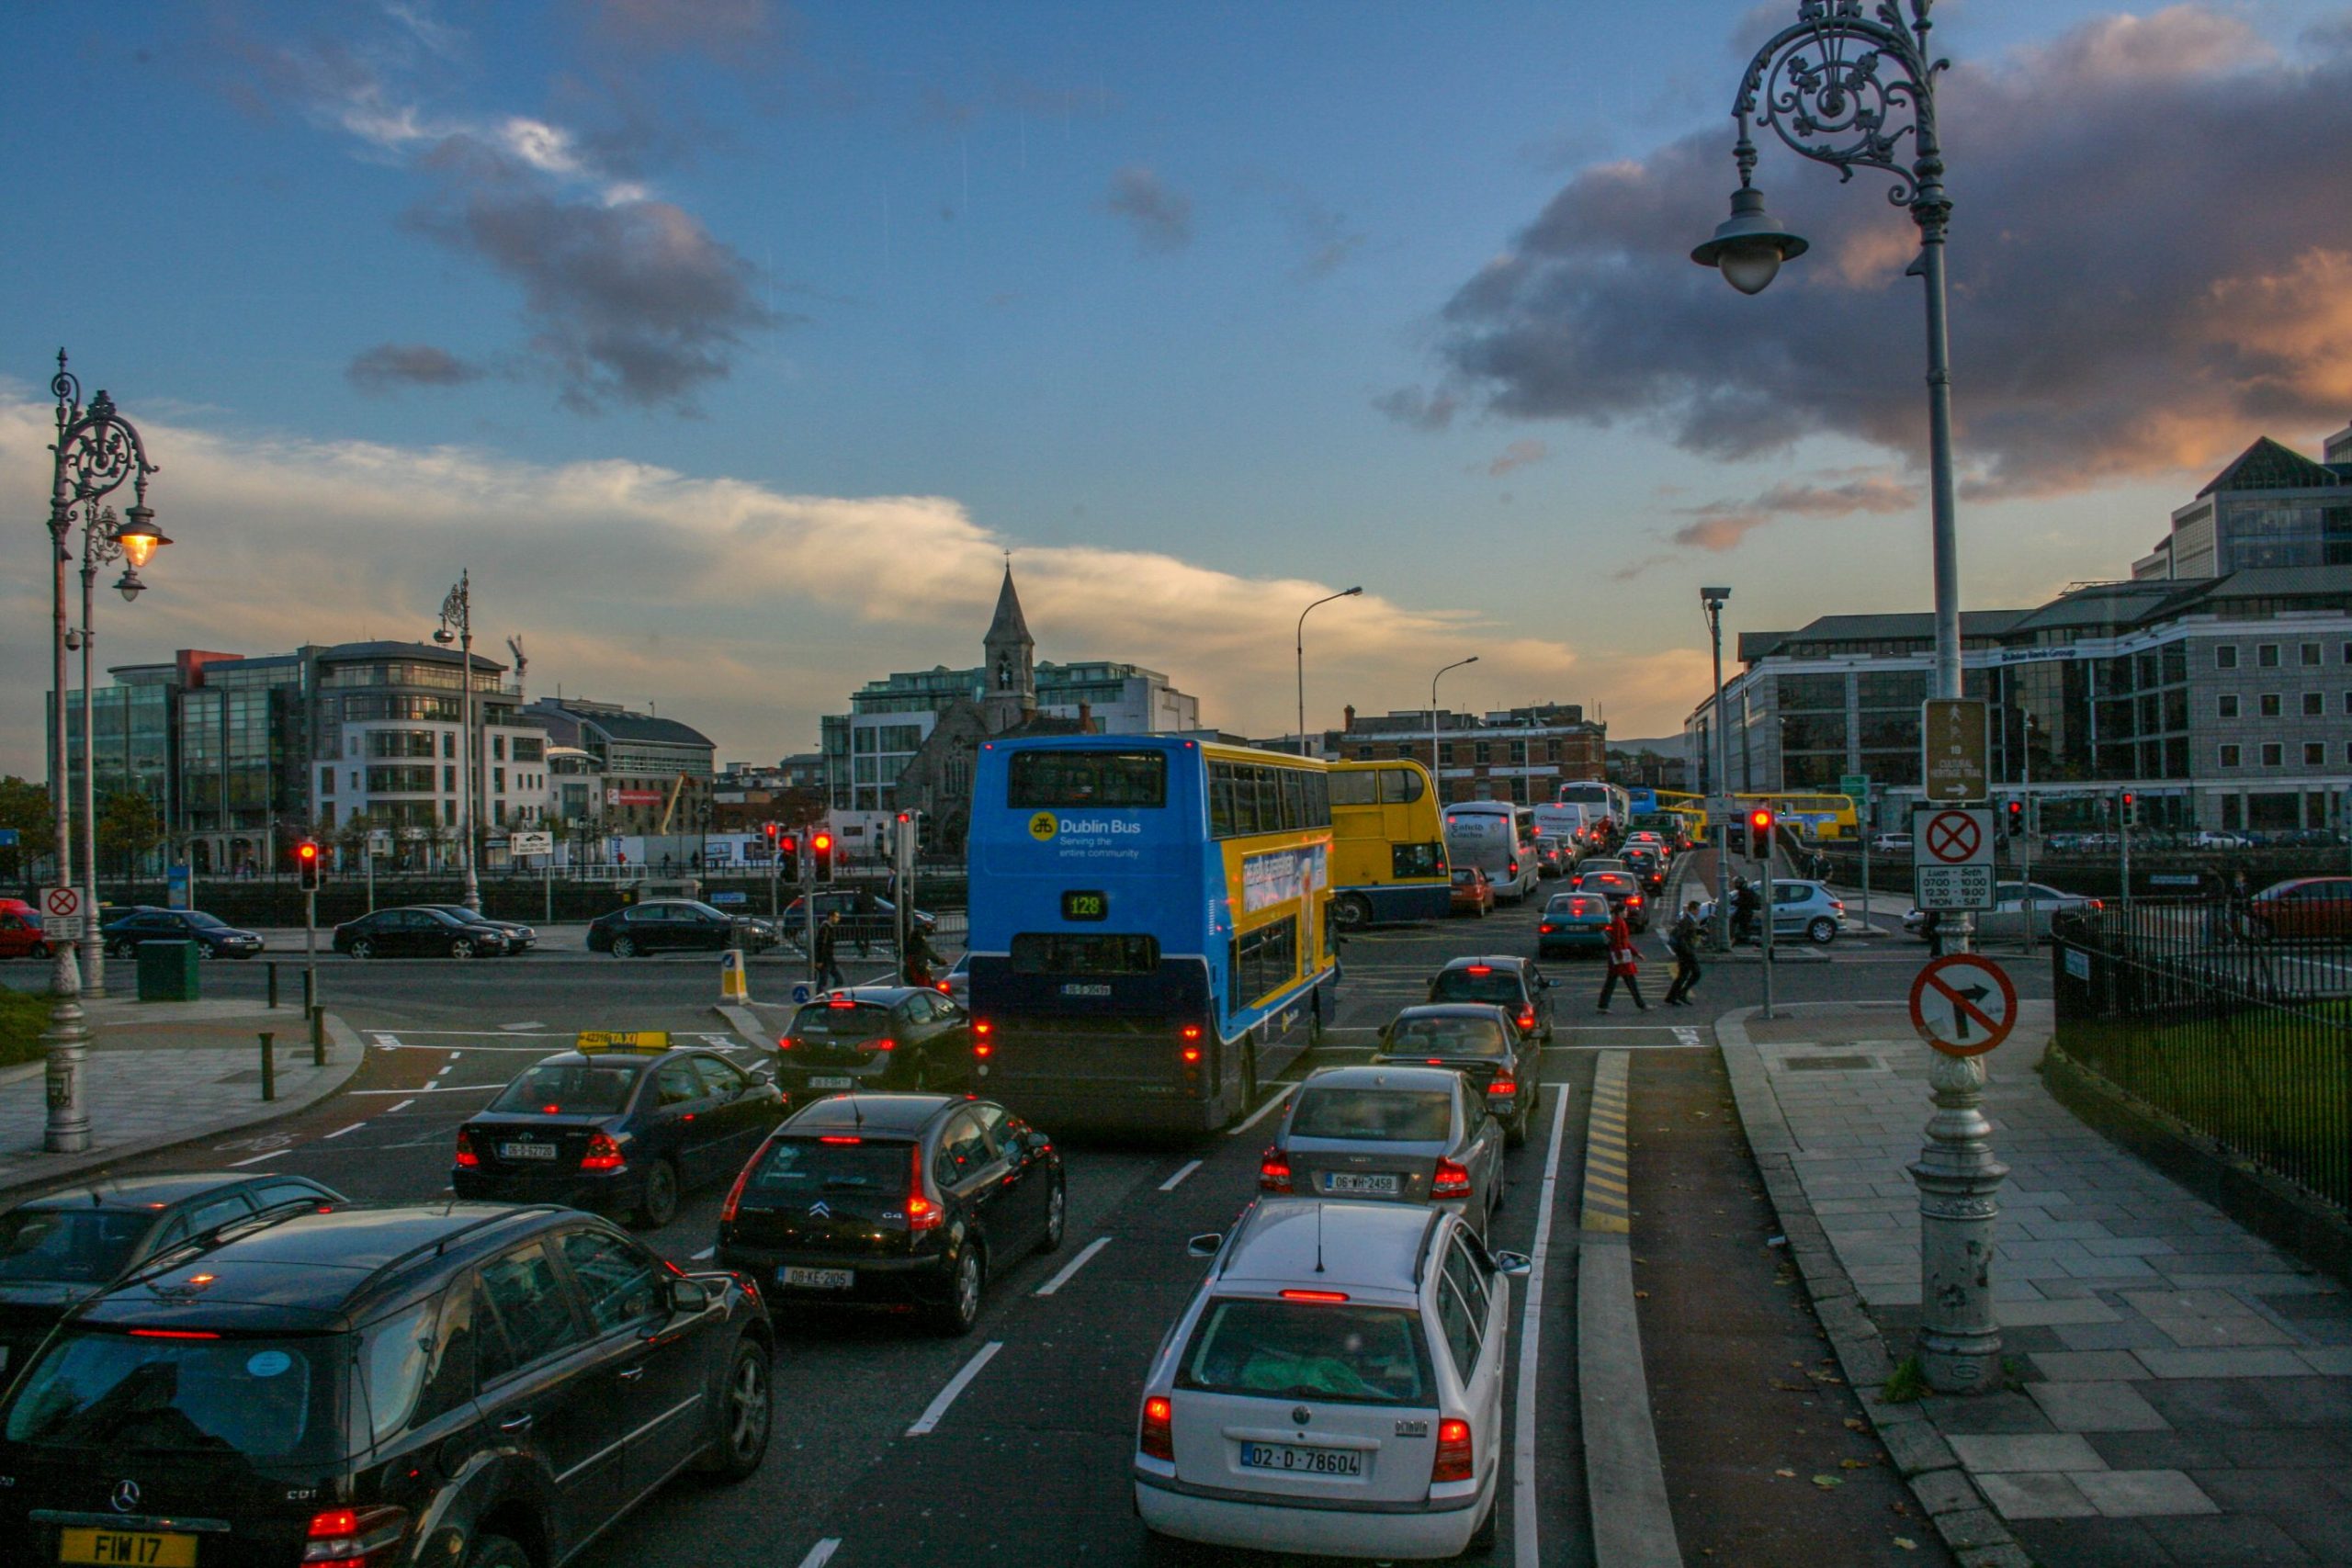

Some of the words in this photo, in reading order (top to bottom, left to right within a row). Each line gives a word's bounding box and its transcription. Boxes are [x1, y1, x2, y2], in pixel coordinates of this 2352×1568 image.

[2049, 648, 2076, 658] Group
[1060, 818, 1108, 833] Dublin
[1111, 818, 1141, 833] Bus
[1059, 836, 1095, 848] Serving
[1097, 836, 1113, 846] the
[1059, 849, 1086, 858] entire
[1087, 848, 1139, 860] community
[1929, 897, 1952, 906] MON
[1963, 897, 1981, 906] SAT
[610, 1032, 637, 1043] TAXI
[1395, 1420, 1428, 1434] OCTAVIA
[140, 1538, 163, 1562] 17
